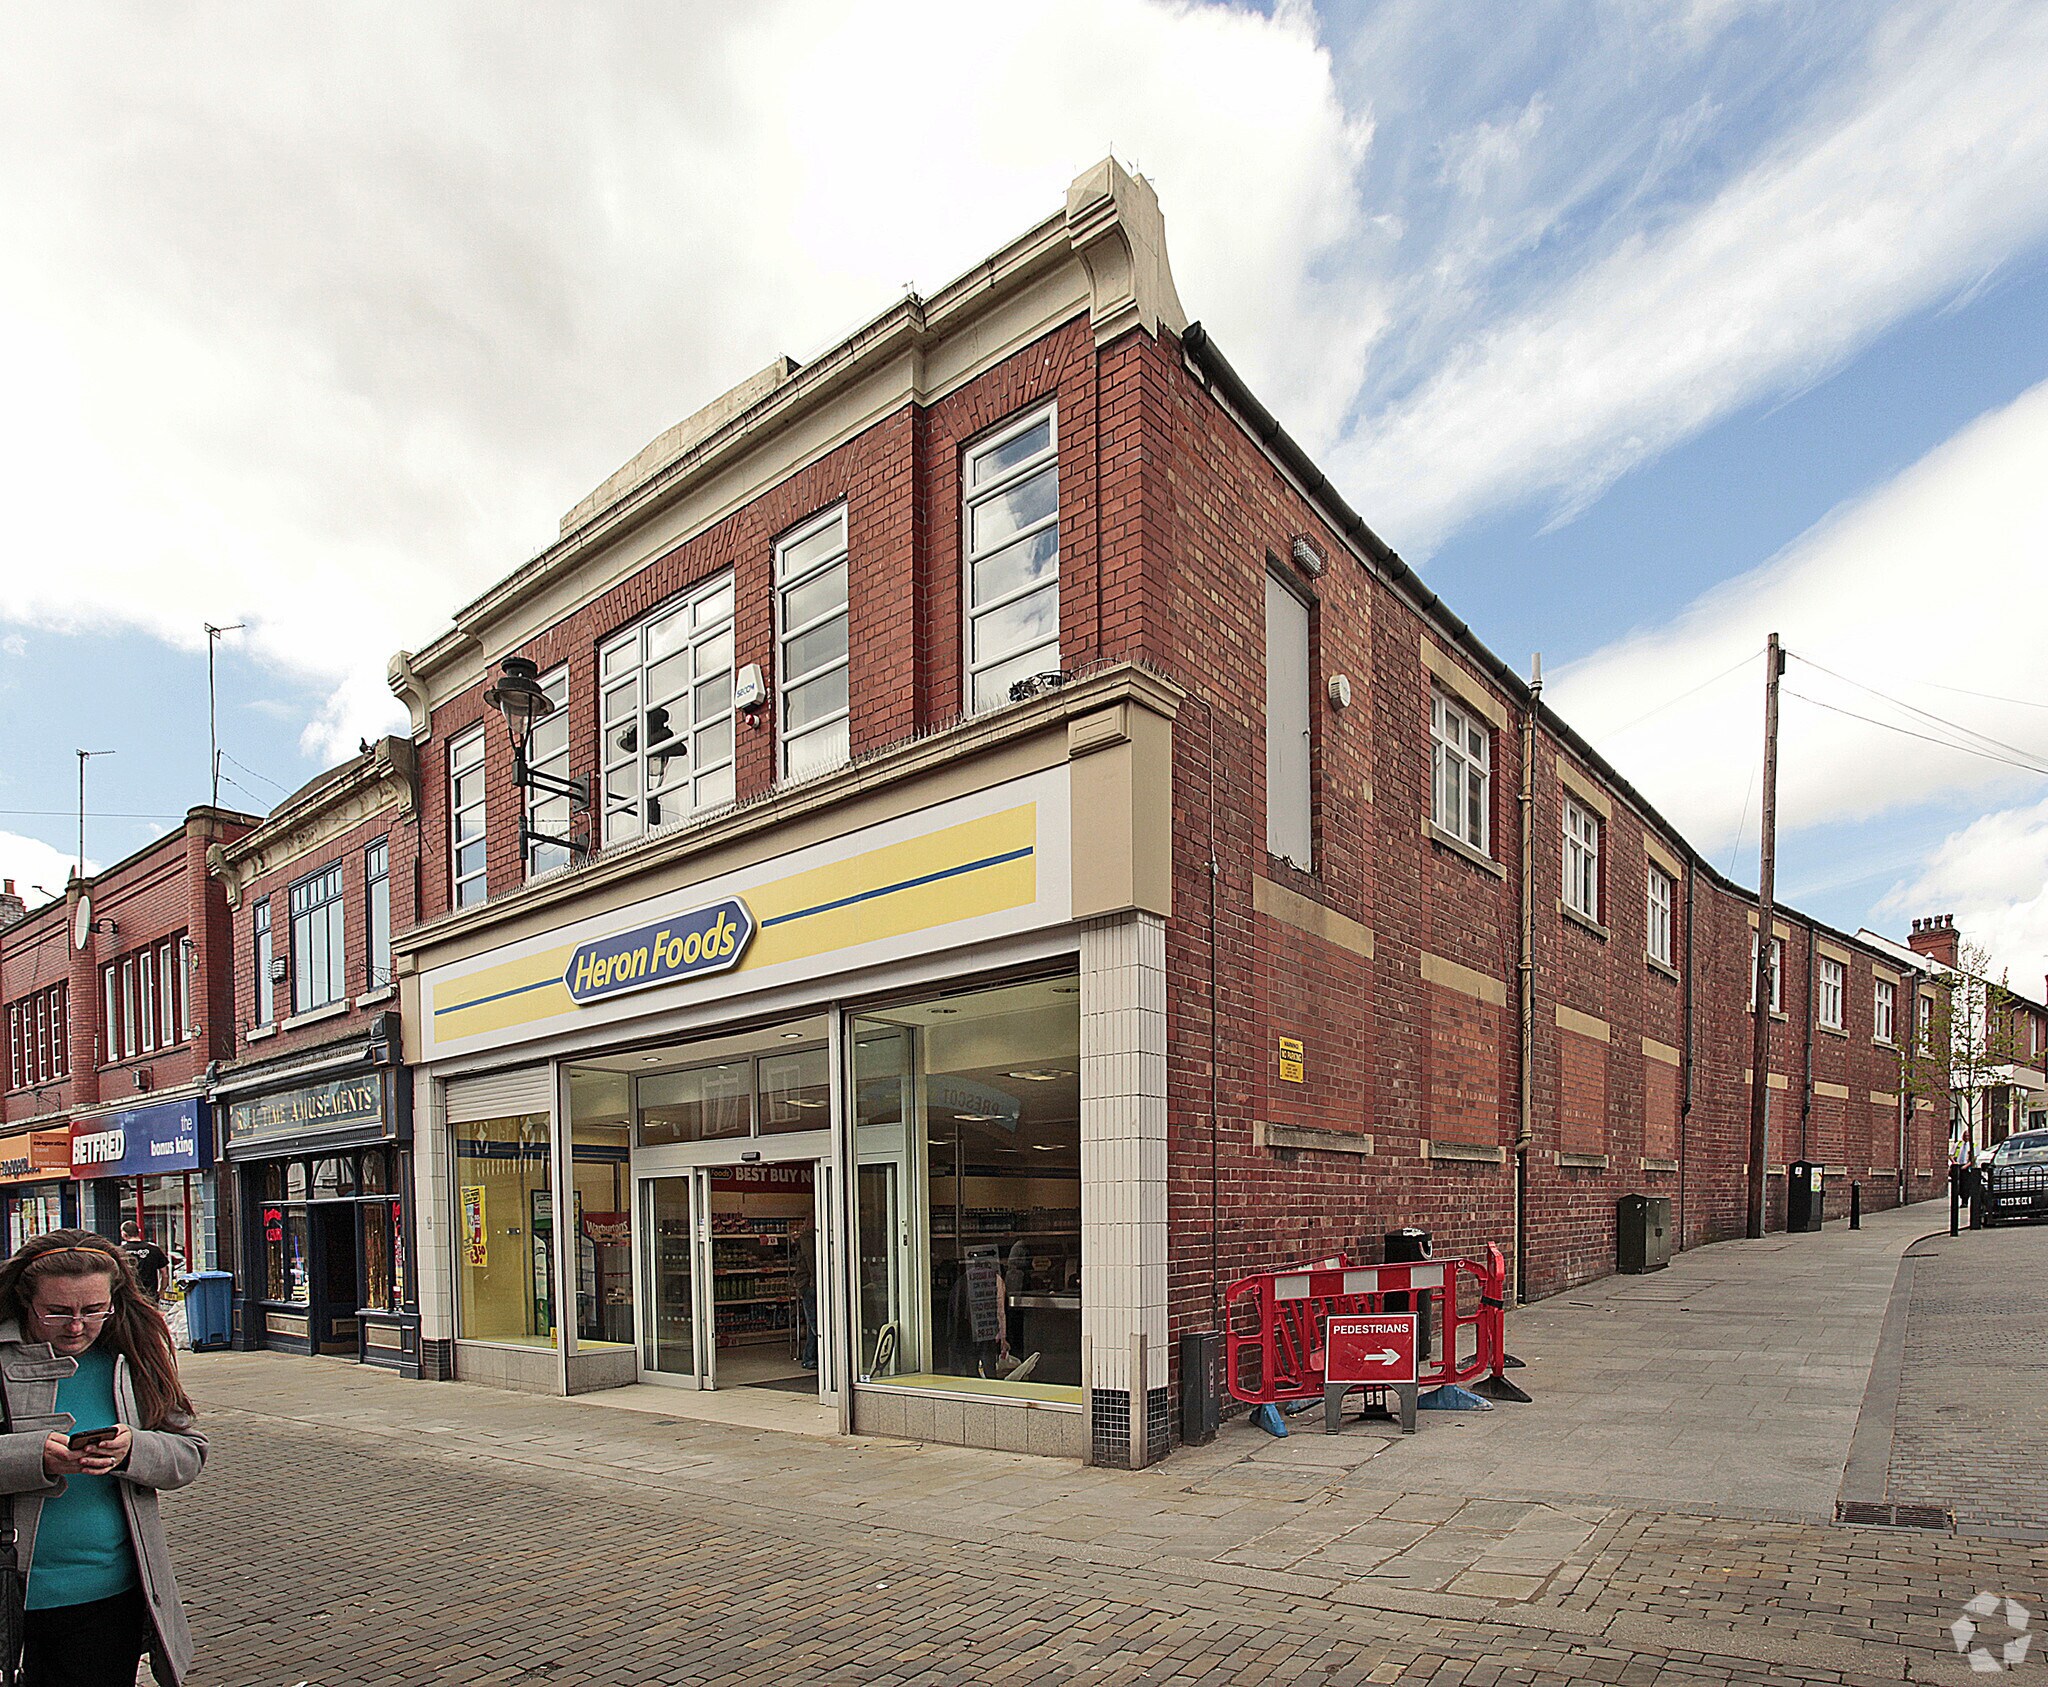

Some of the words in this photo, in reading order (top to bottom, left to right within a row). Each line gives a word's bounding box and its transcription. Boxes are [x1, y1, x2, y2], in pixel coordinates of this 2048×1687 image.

[573, 946, 648, 993] Heron
[650, 911, 737, 974] Foods
[262, 1103, 287, 1126] TIME
[290, 1086, 372, 1122] AMUSEMENTS
[181, 1115, 193, 1132] the
[72, 1129, 125, 1165] BETFRED
[150, 1140, 175, 1157] bonus
[175, 1136, 194, 1157] king
[735, 1166, 768, 1182] BEST
[770, 1168, 798, 1184] BUY
[586, 1219, 629, 1234] Warburtons
[1333, 1323, 1409, 1335] PEDESTRIANS
